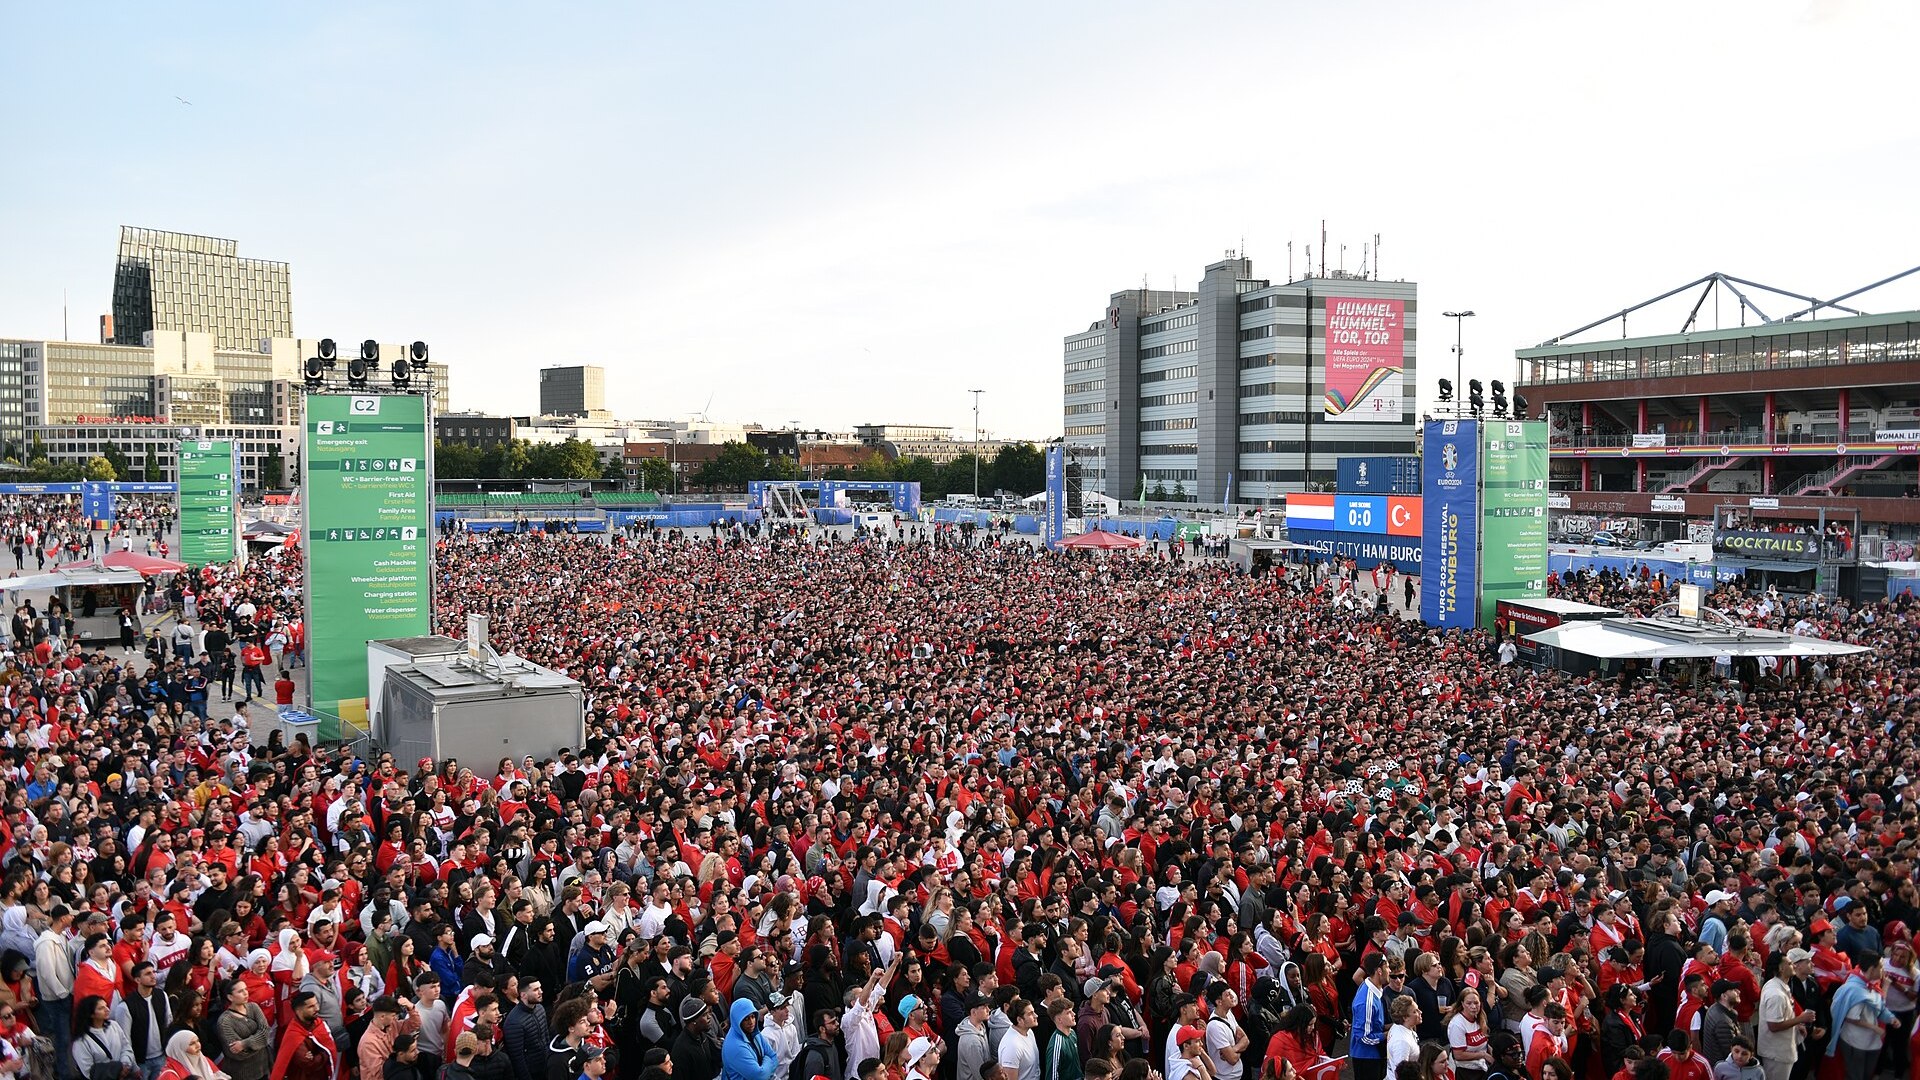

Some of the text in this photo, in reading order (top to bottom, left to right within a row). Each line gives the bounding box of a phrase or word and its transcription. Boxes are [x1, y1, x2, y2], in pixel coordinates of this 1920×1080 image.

[1336, 302, 1396, 319] HUMMEL,
[1330, 316, 1386, 330] HUMMEL
[1333, 330, 1390, 346] TOR, TOR
[355, 400, 375, 411] C2
[1444, 423, 1456, 432] B3
[1508, 425, 1520, 433] B2
[1349, 510, 1371, 526] 0:0
[1337, 542, 1360, 557] CITY
[1725, 537, 1804, 552] COCKTAILS
[1447, 514, 1458, 612] HAMBURG
[585, 964, 594, 975] 2
